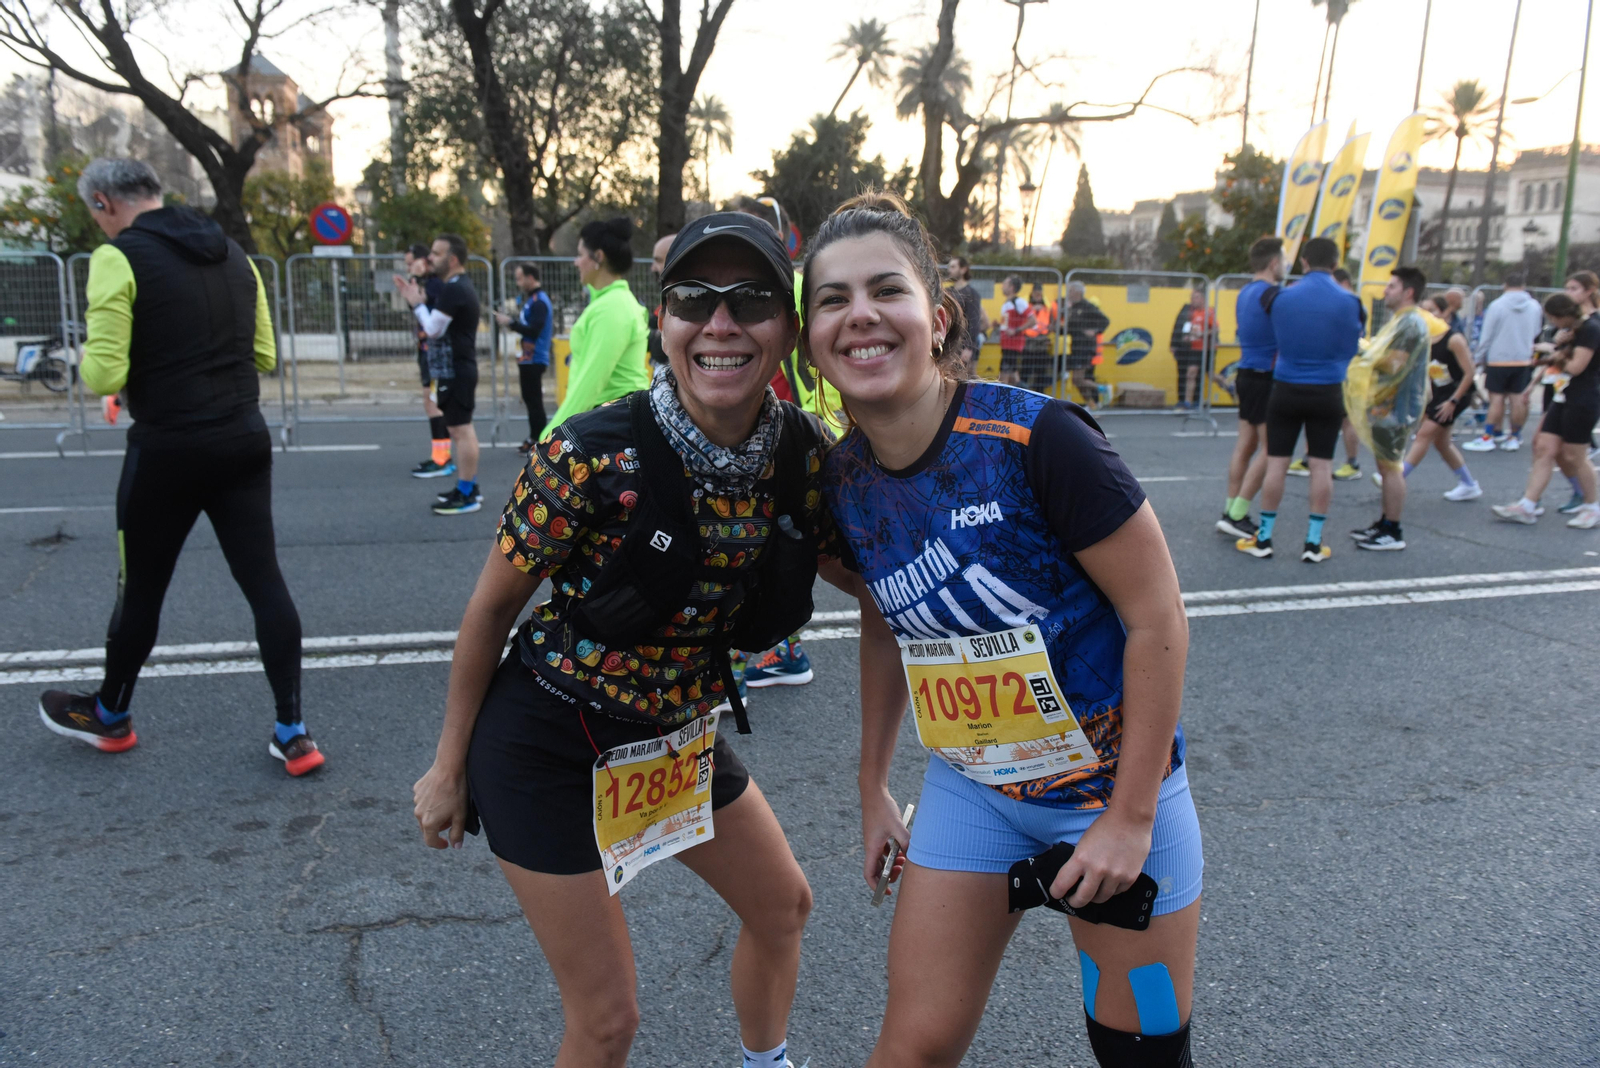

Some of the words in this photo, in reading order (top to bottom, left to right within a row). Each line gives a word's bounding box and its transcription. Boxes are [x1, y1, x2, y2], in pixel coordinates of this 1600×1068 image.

[620, 459, 641, 471] lua
[951, 501, 1004, 531] HOKA
[873, 536, 960, 614] MARATÓN
[907, 643, 925, 657] MEDIO
[925, 641, 955, 657] MARATÓN
[970, 632, 1020, 658] SEVILLA
[534, 675, 577, 705] RESSPOR
[918, 671, 1038, 722] 10972
[630, 737, 664, 758] MARATÓN
[678, 717, 704, 747] SEVILLA
[967, 722, 993, 730] Marion
[605, 751, 699, 819] 12852
[993, 766, 1018, 777] HOKA
[643, 843, 661, 857] HOKA
